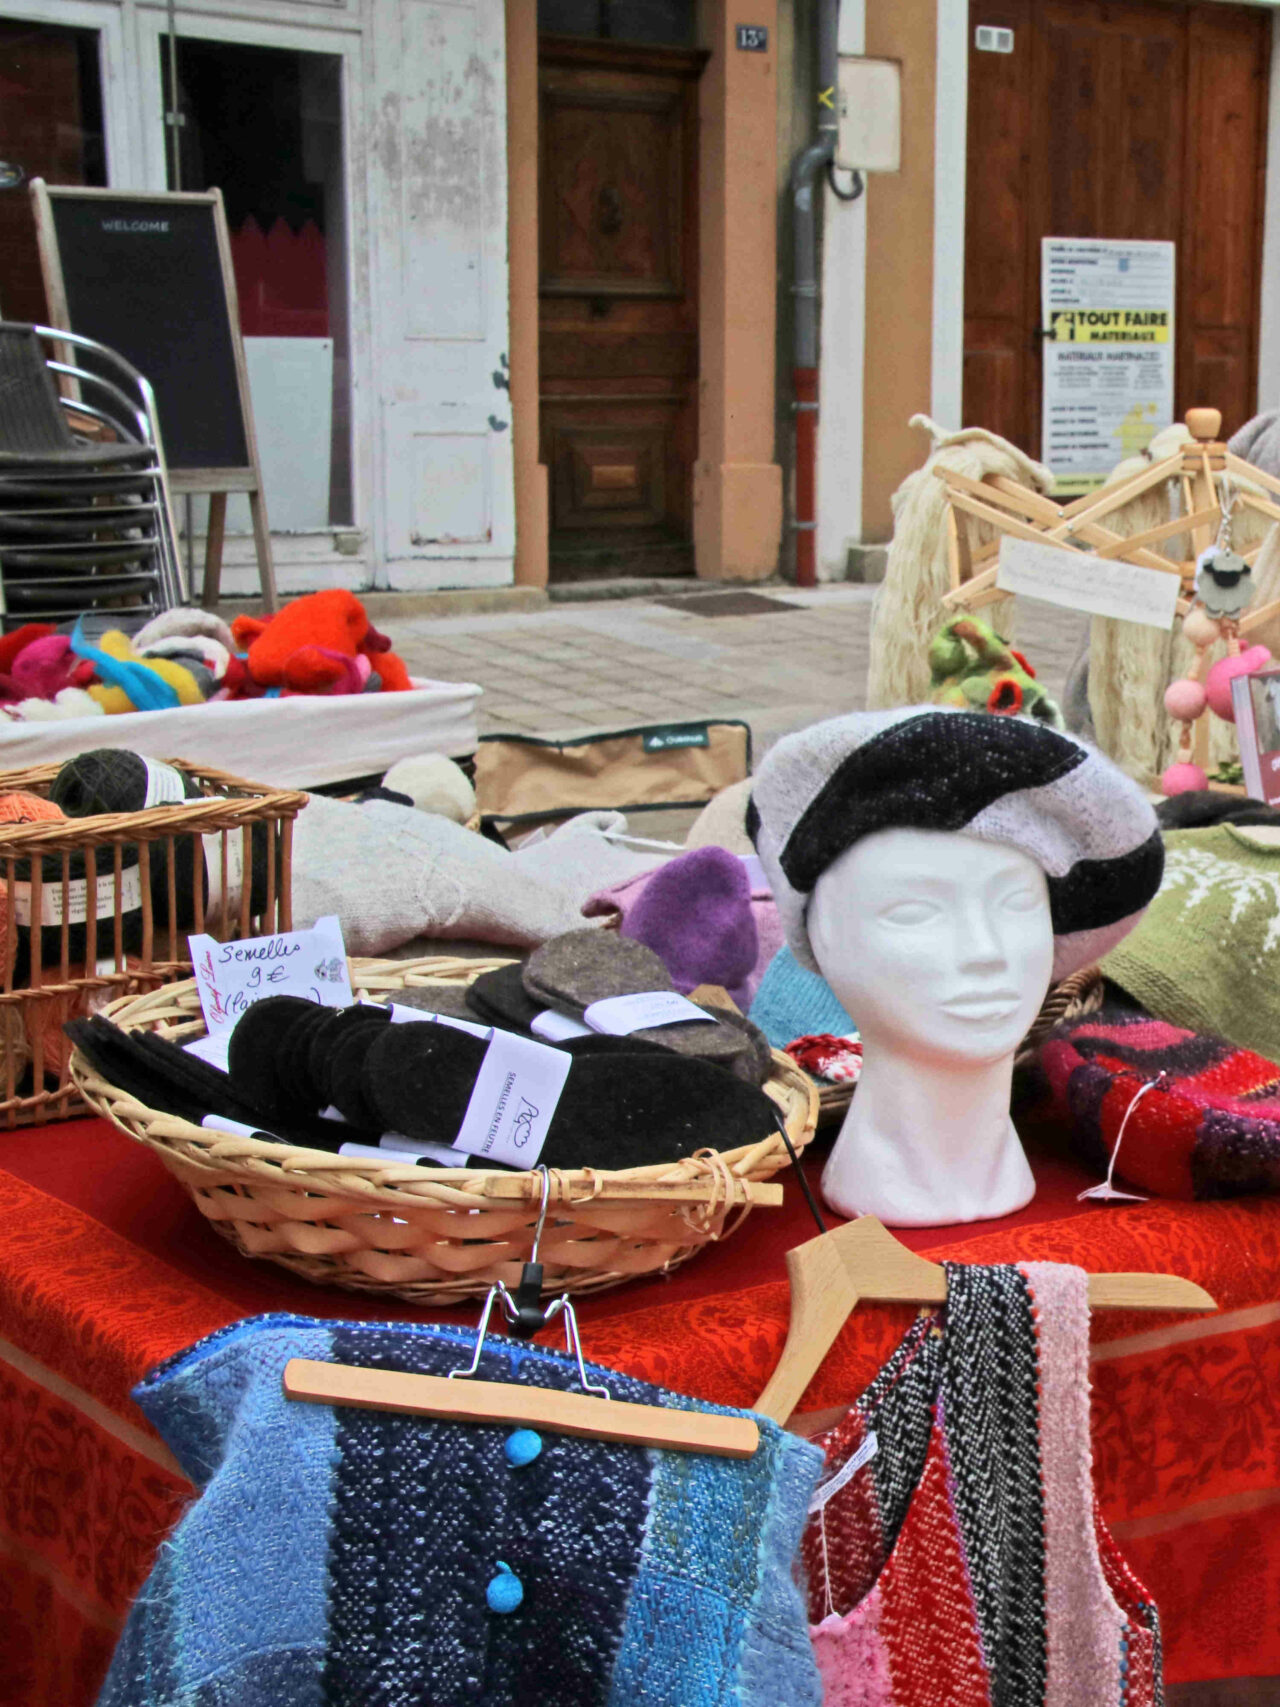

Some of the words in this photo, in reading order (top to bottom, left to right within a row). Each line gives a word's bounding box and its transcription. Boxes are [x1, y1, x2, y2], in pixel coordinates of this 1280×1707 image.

[102, 221, 170, 232] WELCOME
[1078, 312, 1121, 326] TOUT
[1125, 312, 1167, 326] FAIRE
[497, 1071, 517, 1111] SEMELLES
